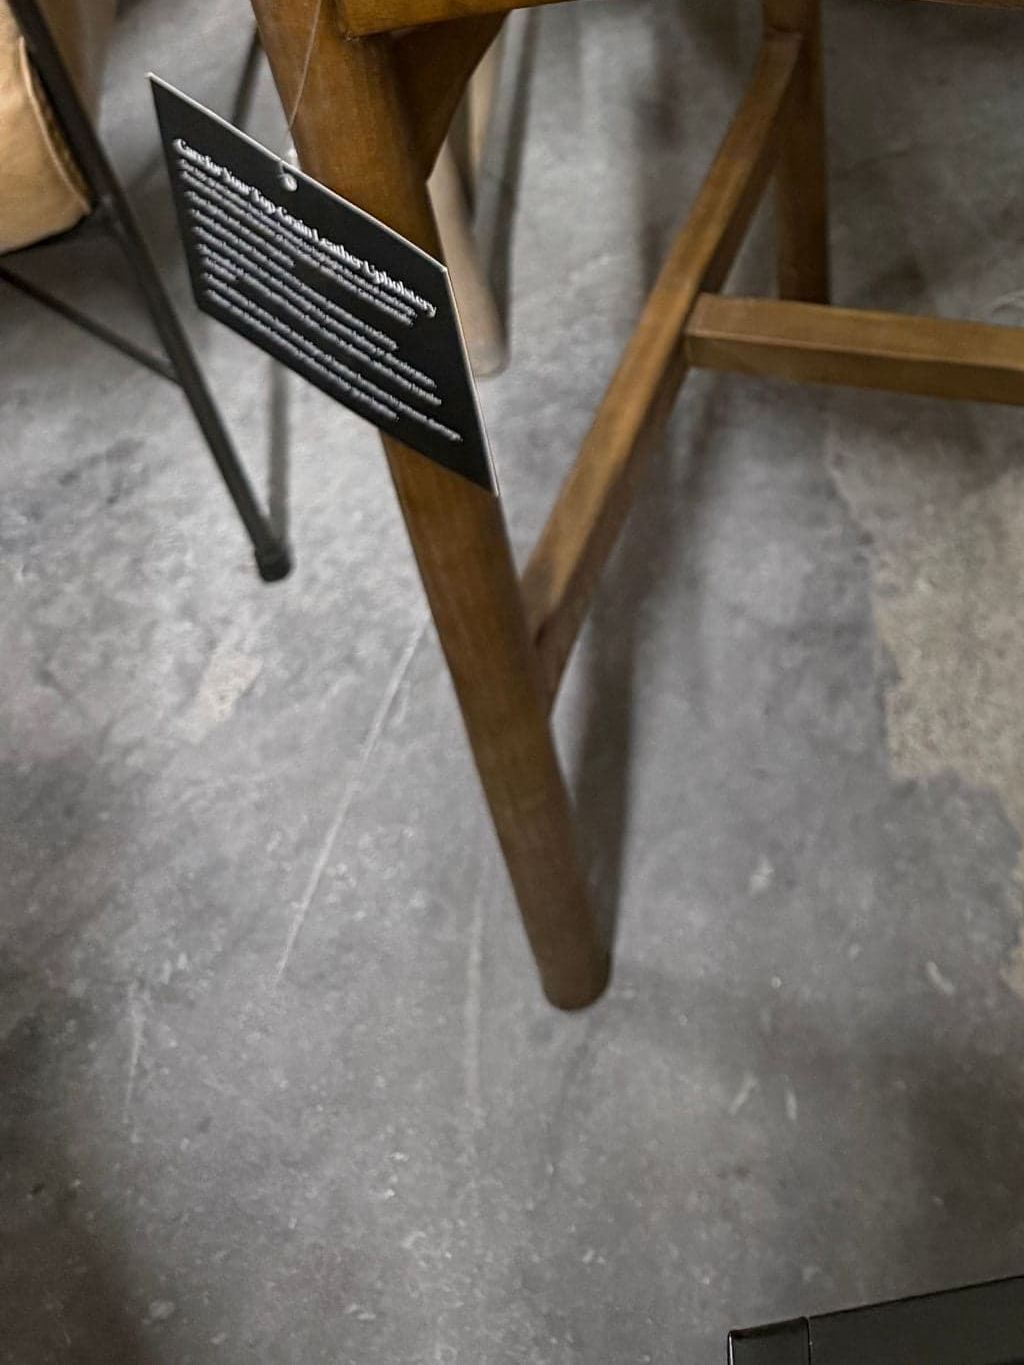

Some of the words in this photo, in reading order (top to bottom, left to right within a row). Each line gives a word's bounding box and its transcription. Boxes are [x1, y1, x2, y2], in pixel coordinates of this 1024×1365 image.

[174, 138, 204, 167] Care
[221, 167, 251, 196] Your
[250, 186, 276, 215] Top
[361, 260, 437, 318] Upholstery
